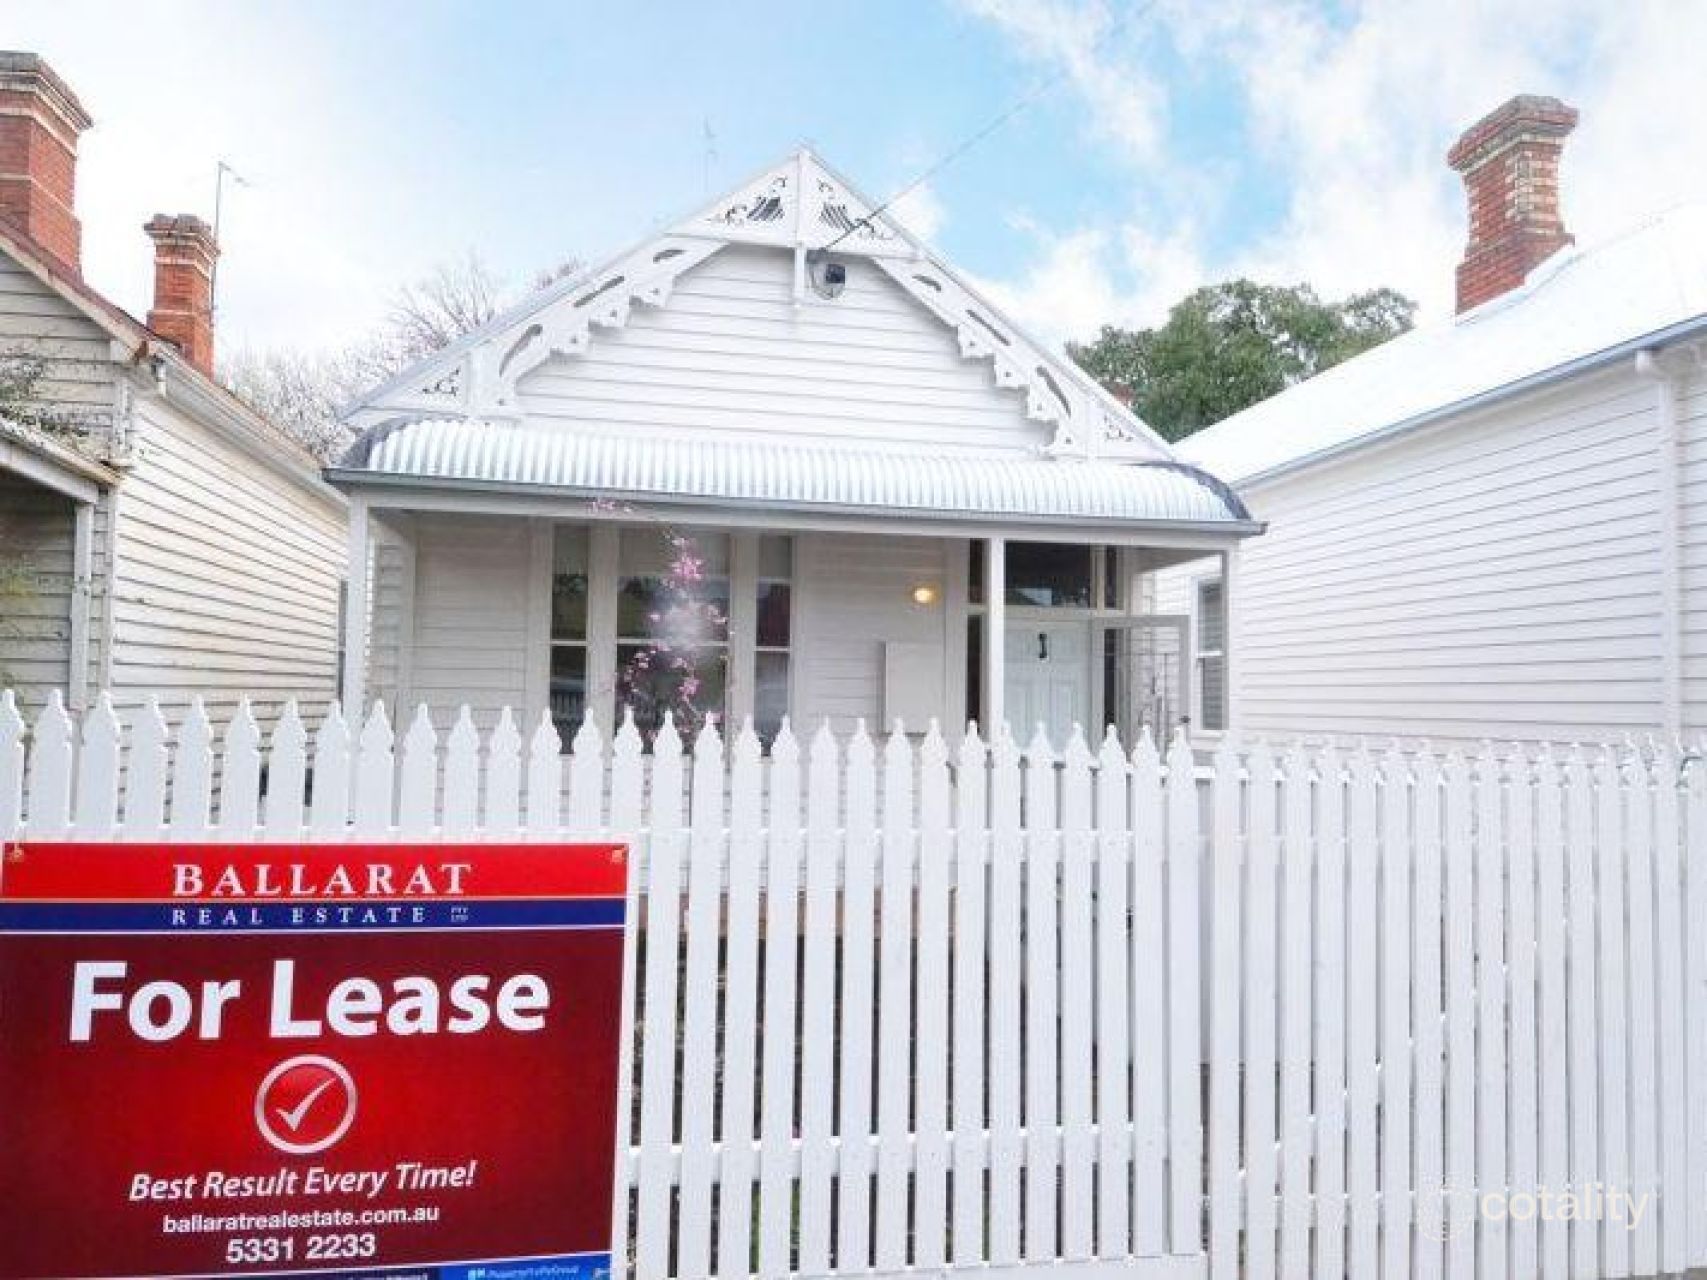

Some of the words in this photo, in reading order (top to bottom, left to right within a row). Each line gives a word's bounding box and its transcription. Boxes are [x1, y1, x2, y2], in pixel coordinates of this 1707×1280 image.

[172, 863, 472, 897] BALLARAT
[172, 907, 263, 926] REAL
[291, 906, 426, 924] ESTATE
[68, 960, 241, 1042] For
[269, 959, 551, 1039] Lease
[130, 1173, 198, 1201] Best
[202, 1167, 298, 1199] Result
[304, 1166, 389, 1199] Every
[395, 1160, 478, 1190] Time!
[162, 1206, 440, 1234] ballaratrealestate.com.au
[226, 1236, 294, 1264] 5331
[304, 1232, 377, 1260] 2233
